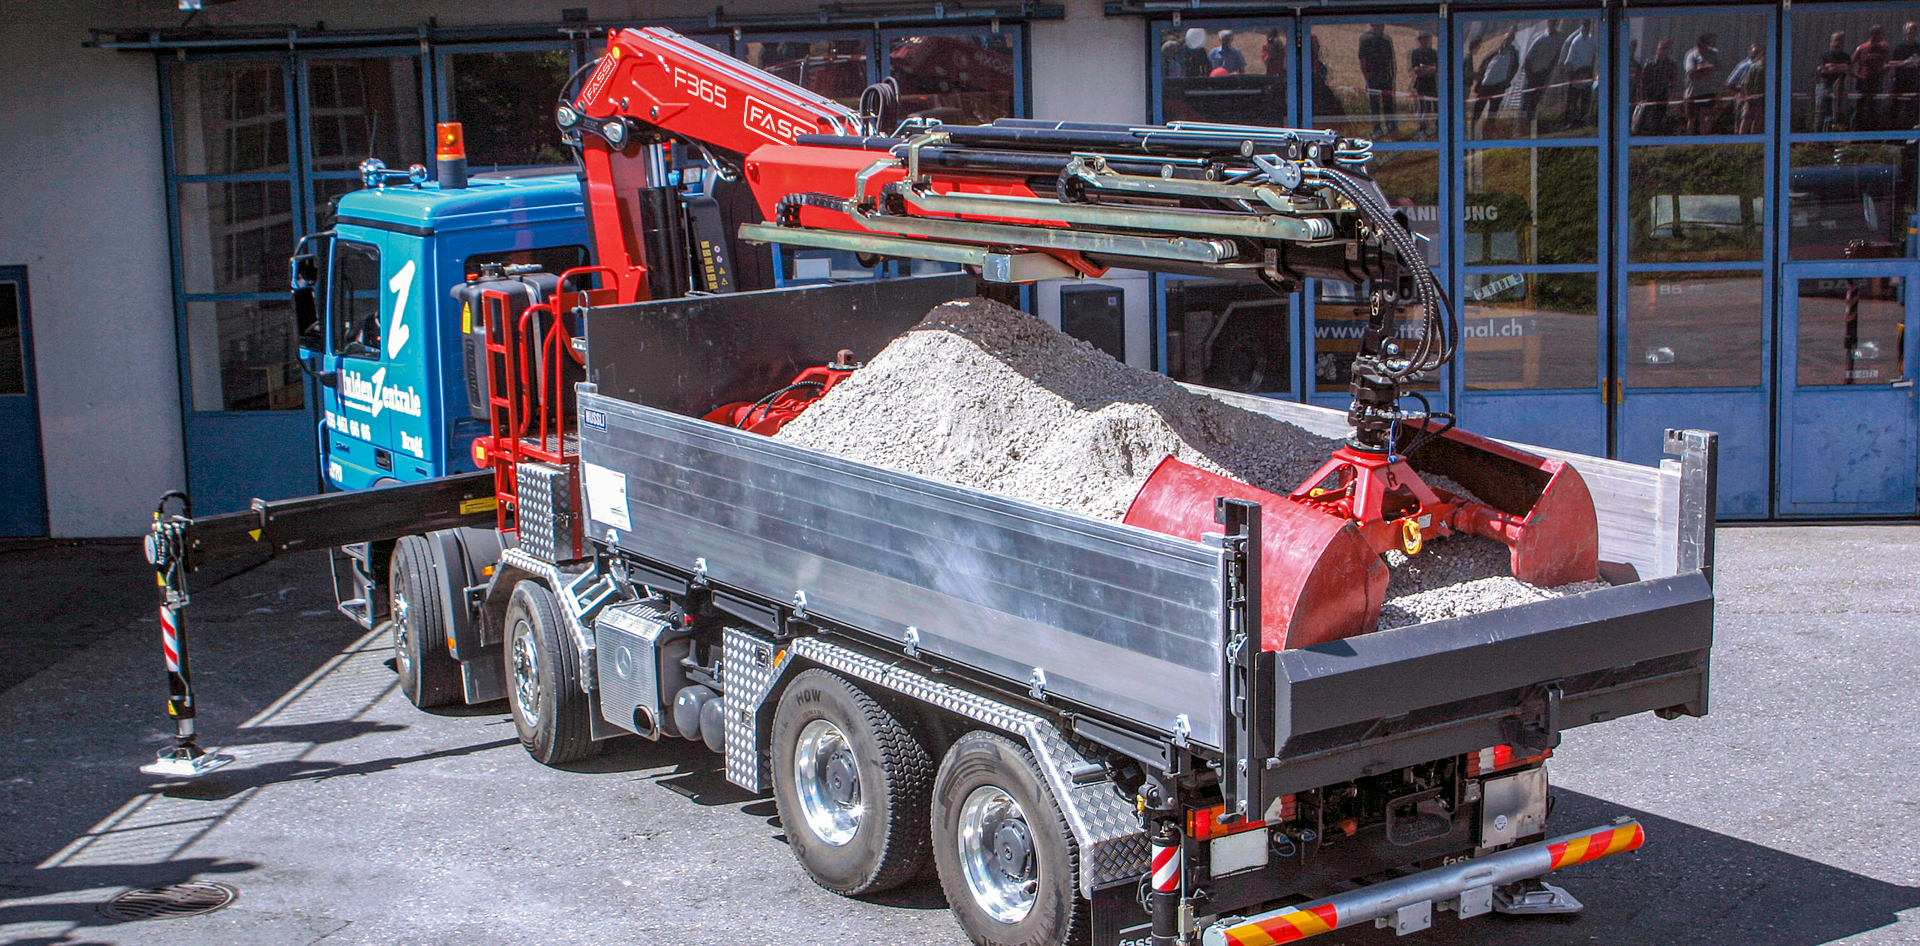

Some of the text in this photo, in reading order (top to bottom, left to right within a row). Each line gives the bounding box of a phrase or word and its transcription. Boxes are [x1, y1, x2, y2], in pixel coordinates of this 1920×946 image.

[586, 58, 613, 100] FASSI
[674, 66, 727, 109] F365
[749, 105, 813, 143] FASS
